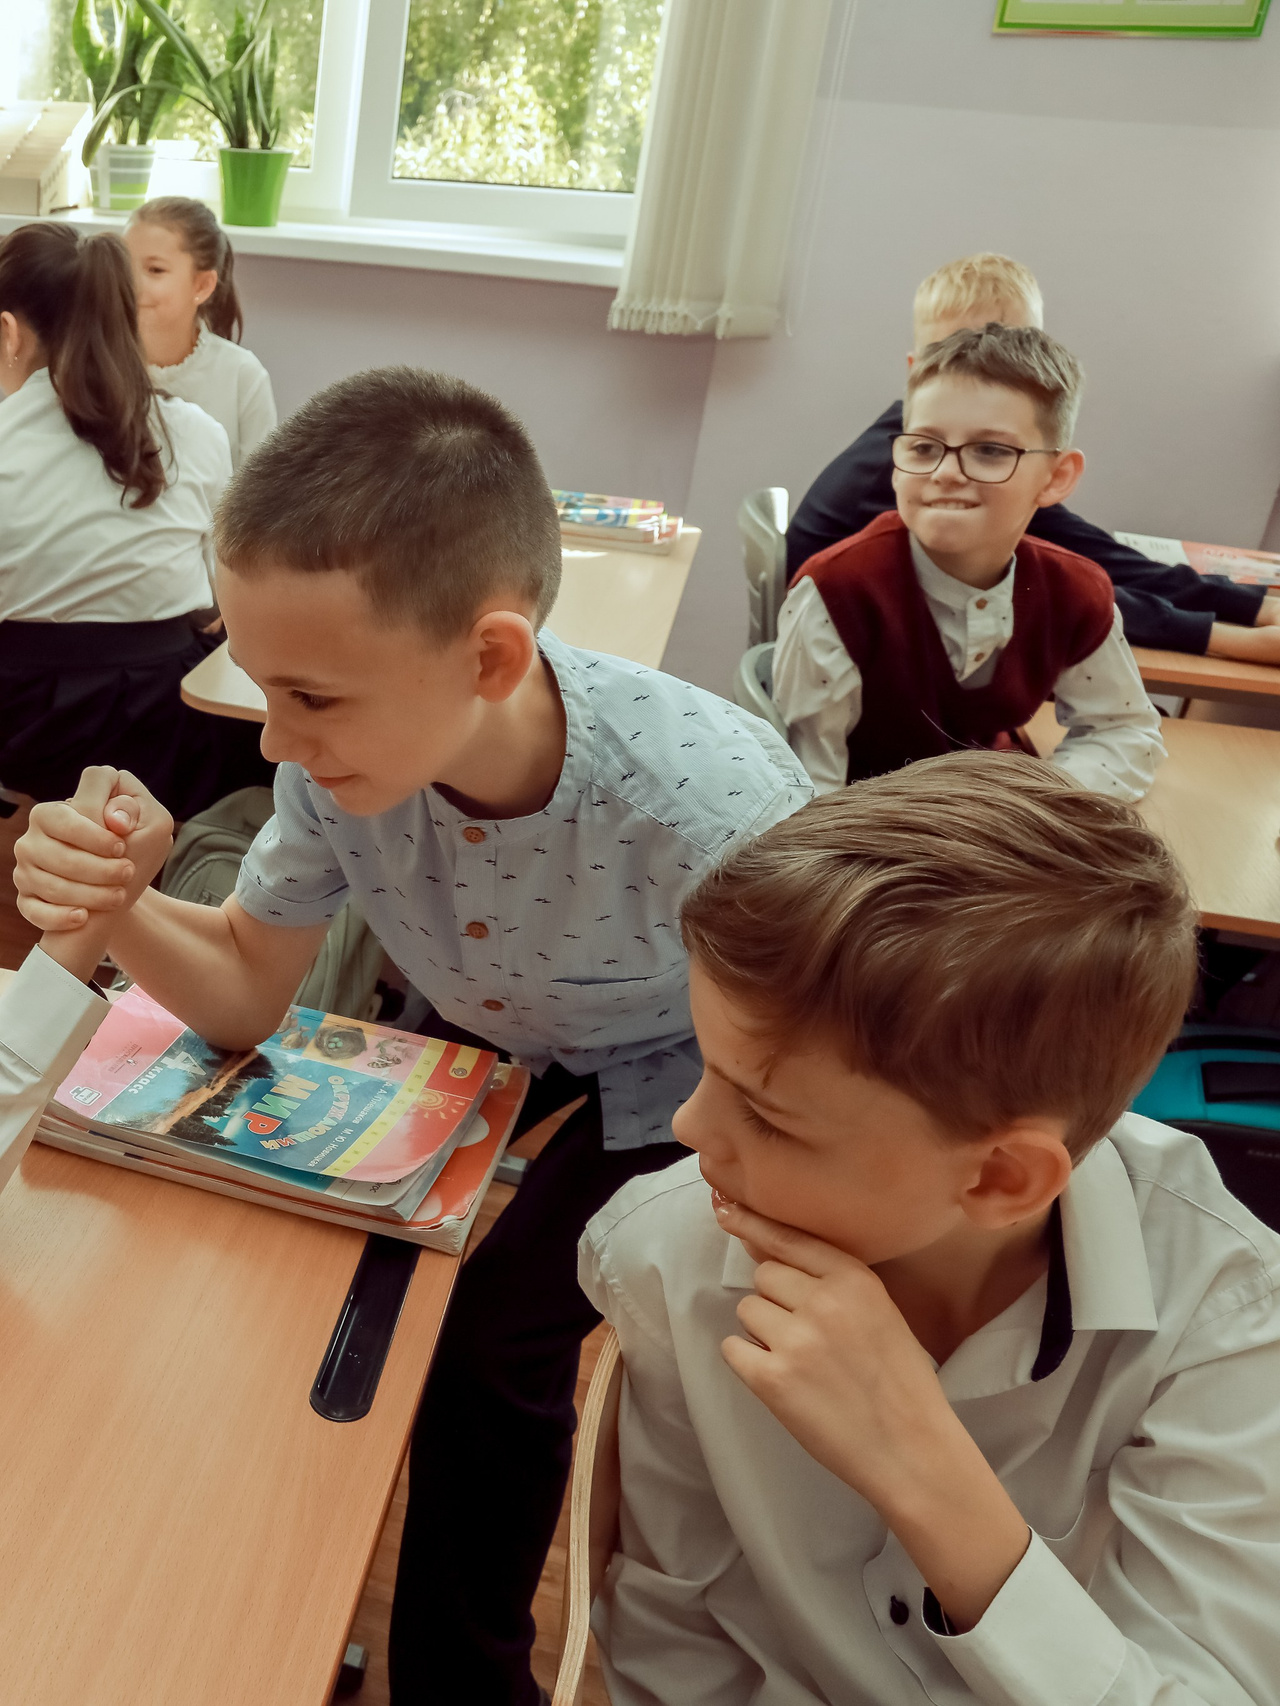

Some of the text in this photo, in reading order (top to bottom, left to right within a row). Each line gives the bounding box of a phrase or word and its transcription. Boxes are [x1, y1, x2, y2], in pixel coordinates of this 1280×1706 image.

[128, 1051, 207, 1095] 4 класс
[242, 1073, 320, 1135] МИР
[259, 1075, 351, 1151] ОКРУЖАЮЩИЙ
[352, 1096, 383, 1124] Плешаков
[307, 1142, 339, 1168] Новицкая
